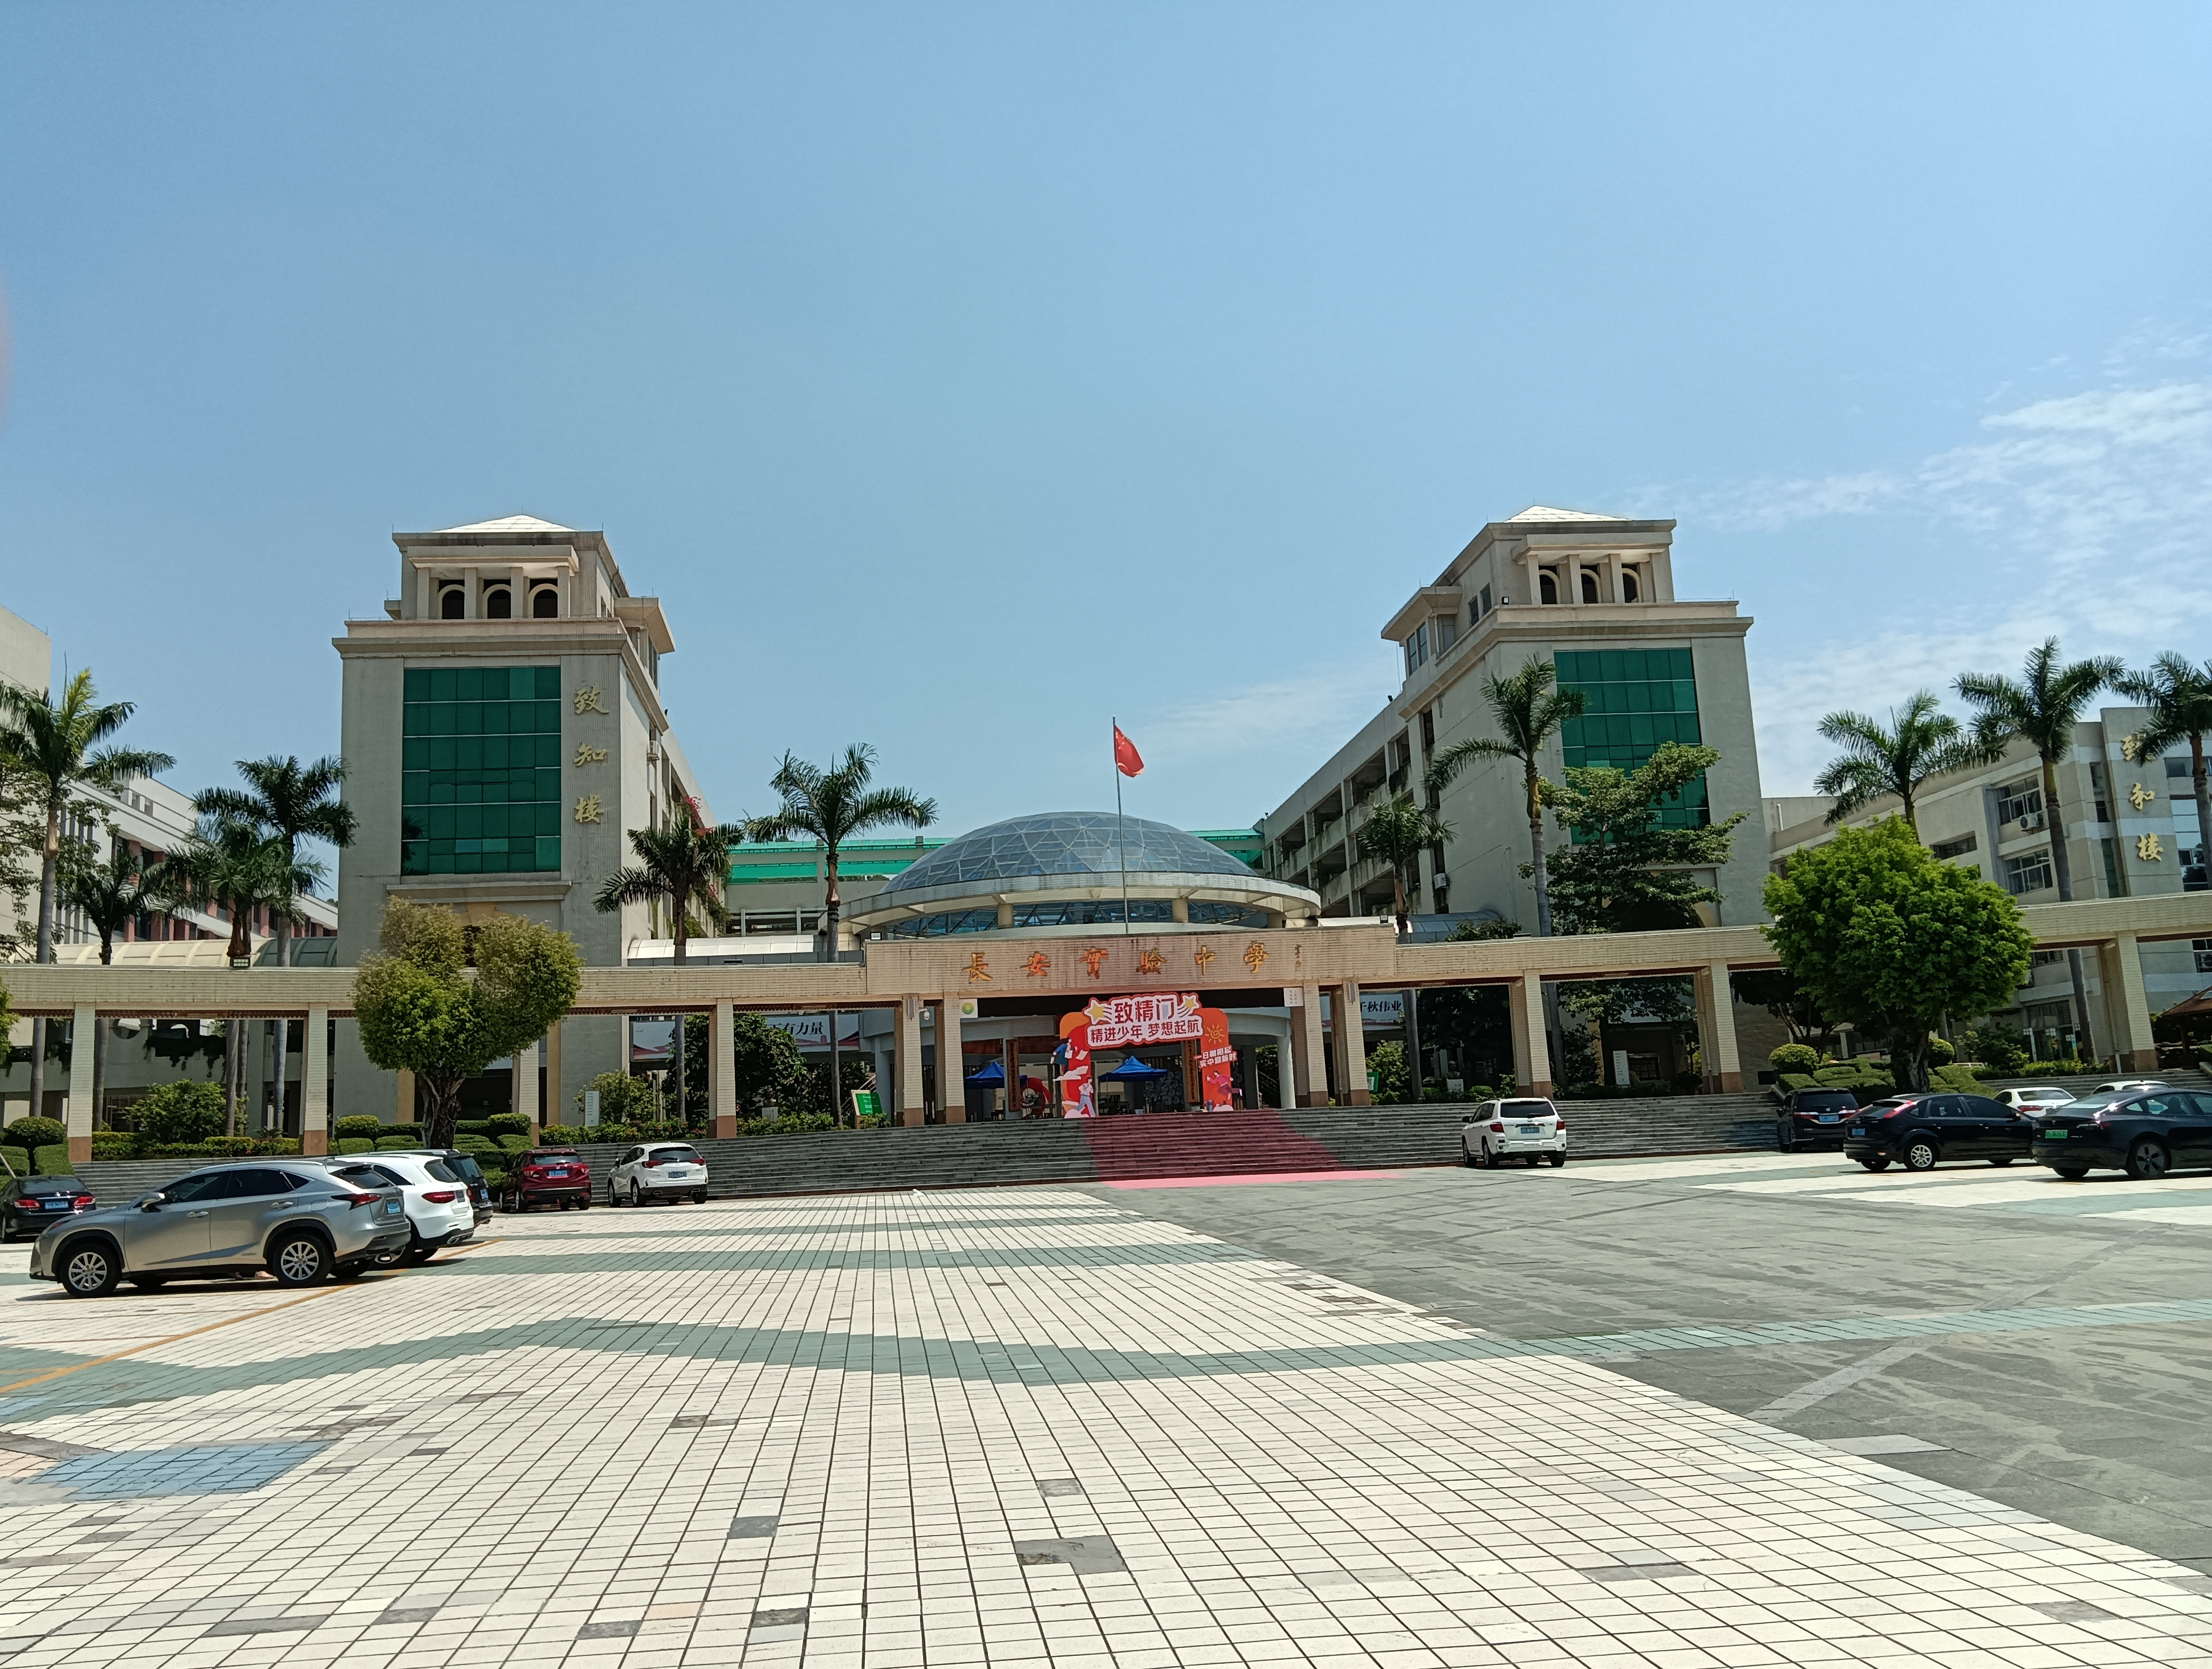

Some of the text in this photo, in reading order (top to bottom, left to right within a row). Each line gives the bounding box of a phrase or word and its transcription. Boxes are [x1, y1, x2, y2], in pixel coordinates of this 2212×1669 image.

[574, 686, 609, 823] 致知楼
[1115, 998, 1174, 1024] 致精门
[1091, 1019, 1199, 1043] 精进少年 梦想起航
